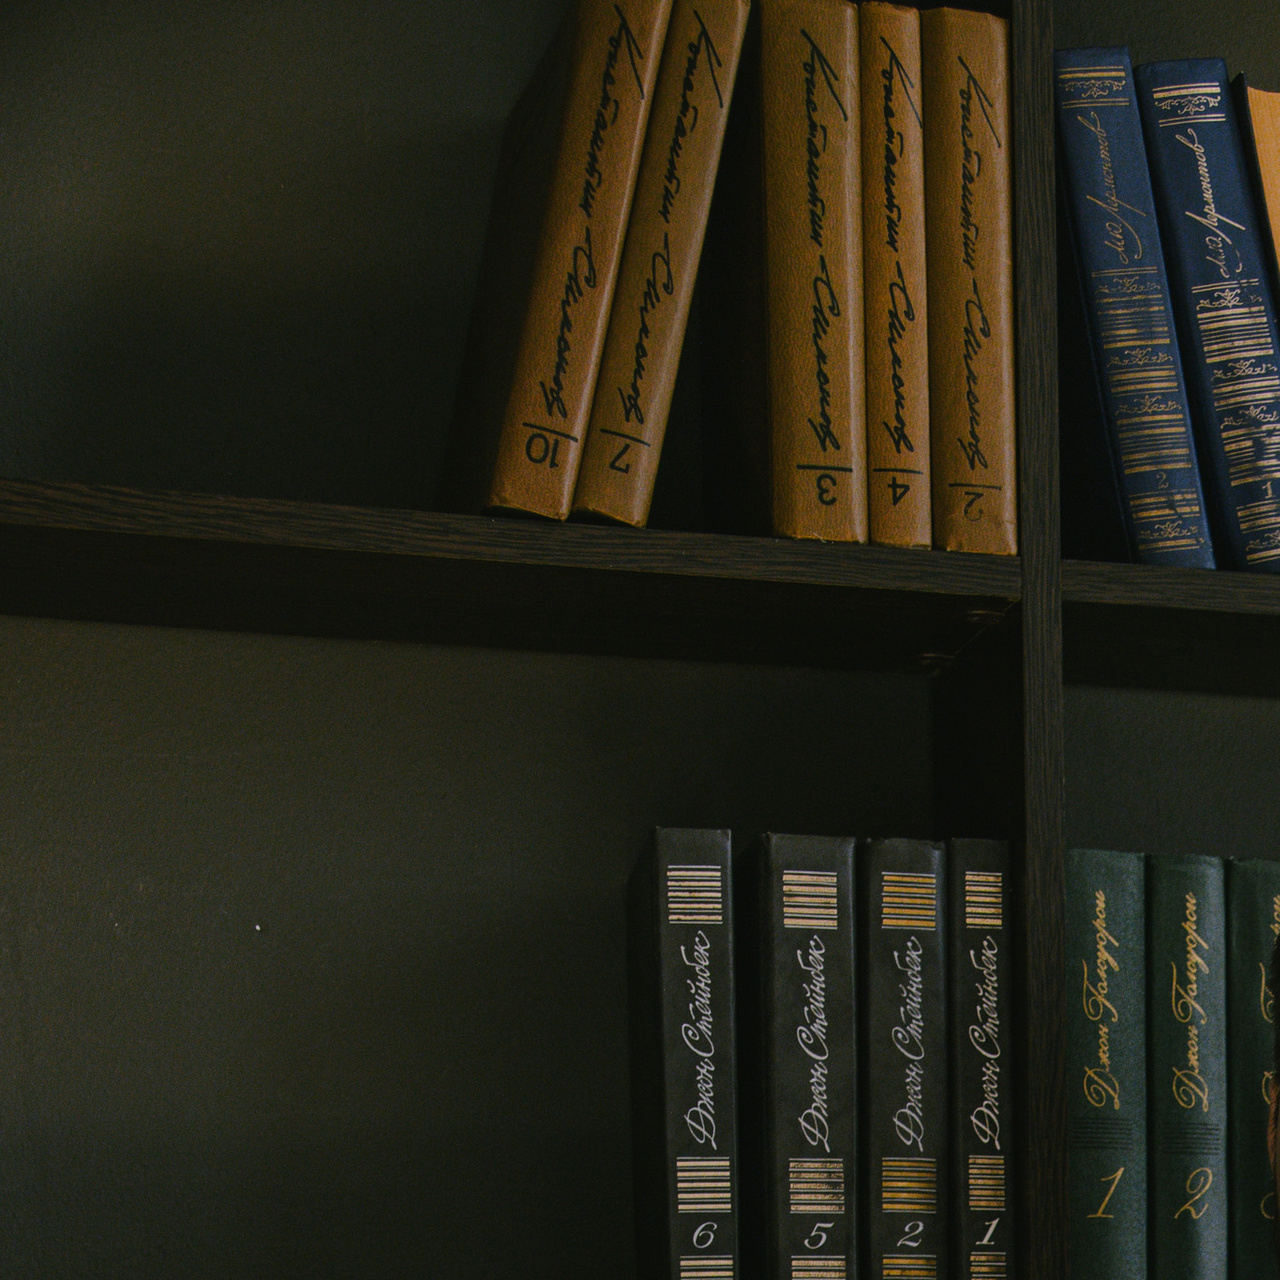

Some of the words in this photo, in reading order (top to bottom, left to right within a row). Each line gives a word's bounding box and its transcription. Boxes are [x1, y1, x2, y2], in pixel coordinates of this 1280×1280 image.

[526, 436, 559, 468] 10
[609, 447, 630, 474] 7
[817, 474, 838, 506] 3
[886, 483, 910, 506] 4
[964, 491, 984, 522] 2
[1156, 472, 1167, 489] 2
[681, 930, 715, 1058] Стейнбек
[797, 936, 830, 1061] Стейнбек
[891, 936, 925, 1060] Стейнбек
[969, 936, 1001, 1058] Стейнбек
[1083, 1023, 1121, 1110] Джон
[1172, 1024, 1209, 1112] Джон
[683, 1059, 717, 1150] Джон
[799, 1060, 830, 1153] Джон
[893, 1059, 925, 1152] Джон
[970, 1058, 1001, 1150] Джон
[1086, 1167, 1124, 1219] 1
[1174, 1167, 1212, 1220] 2
[693, 1221, 717, 1249] 6
[805, 1223, 835, 1250] 5
[896, 1220, 925, 1248] 2
[975, 1219, 1001, 1246] 1
